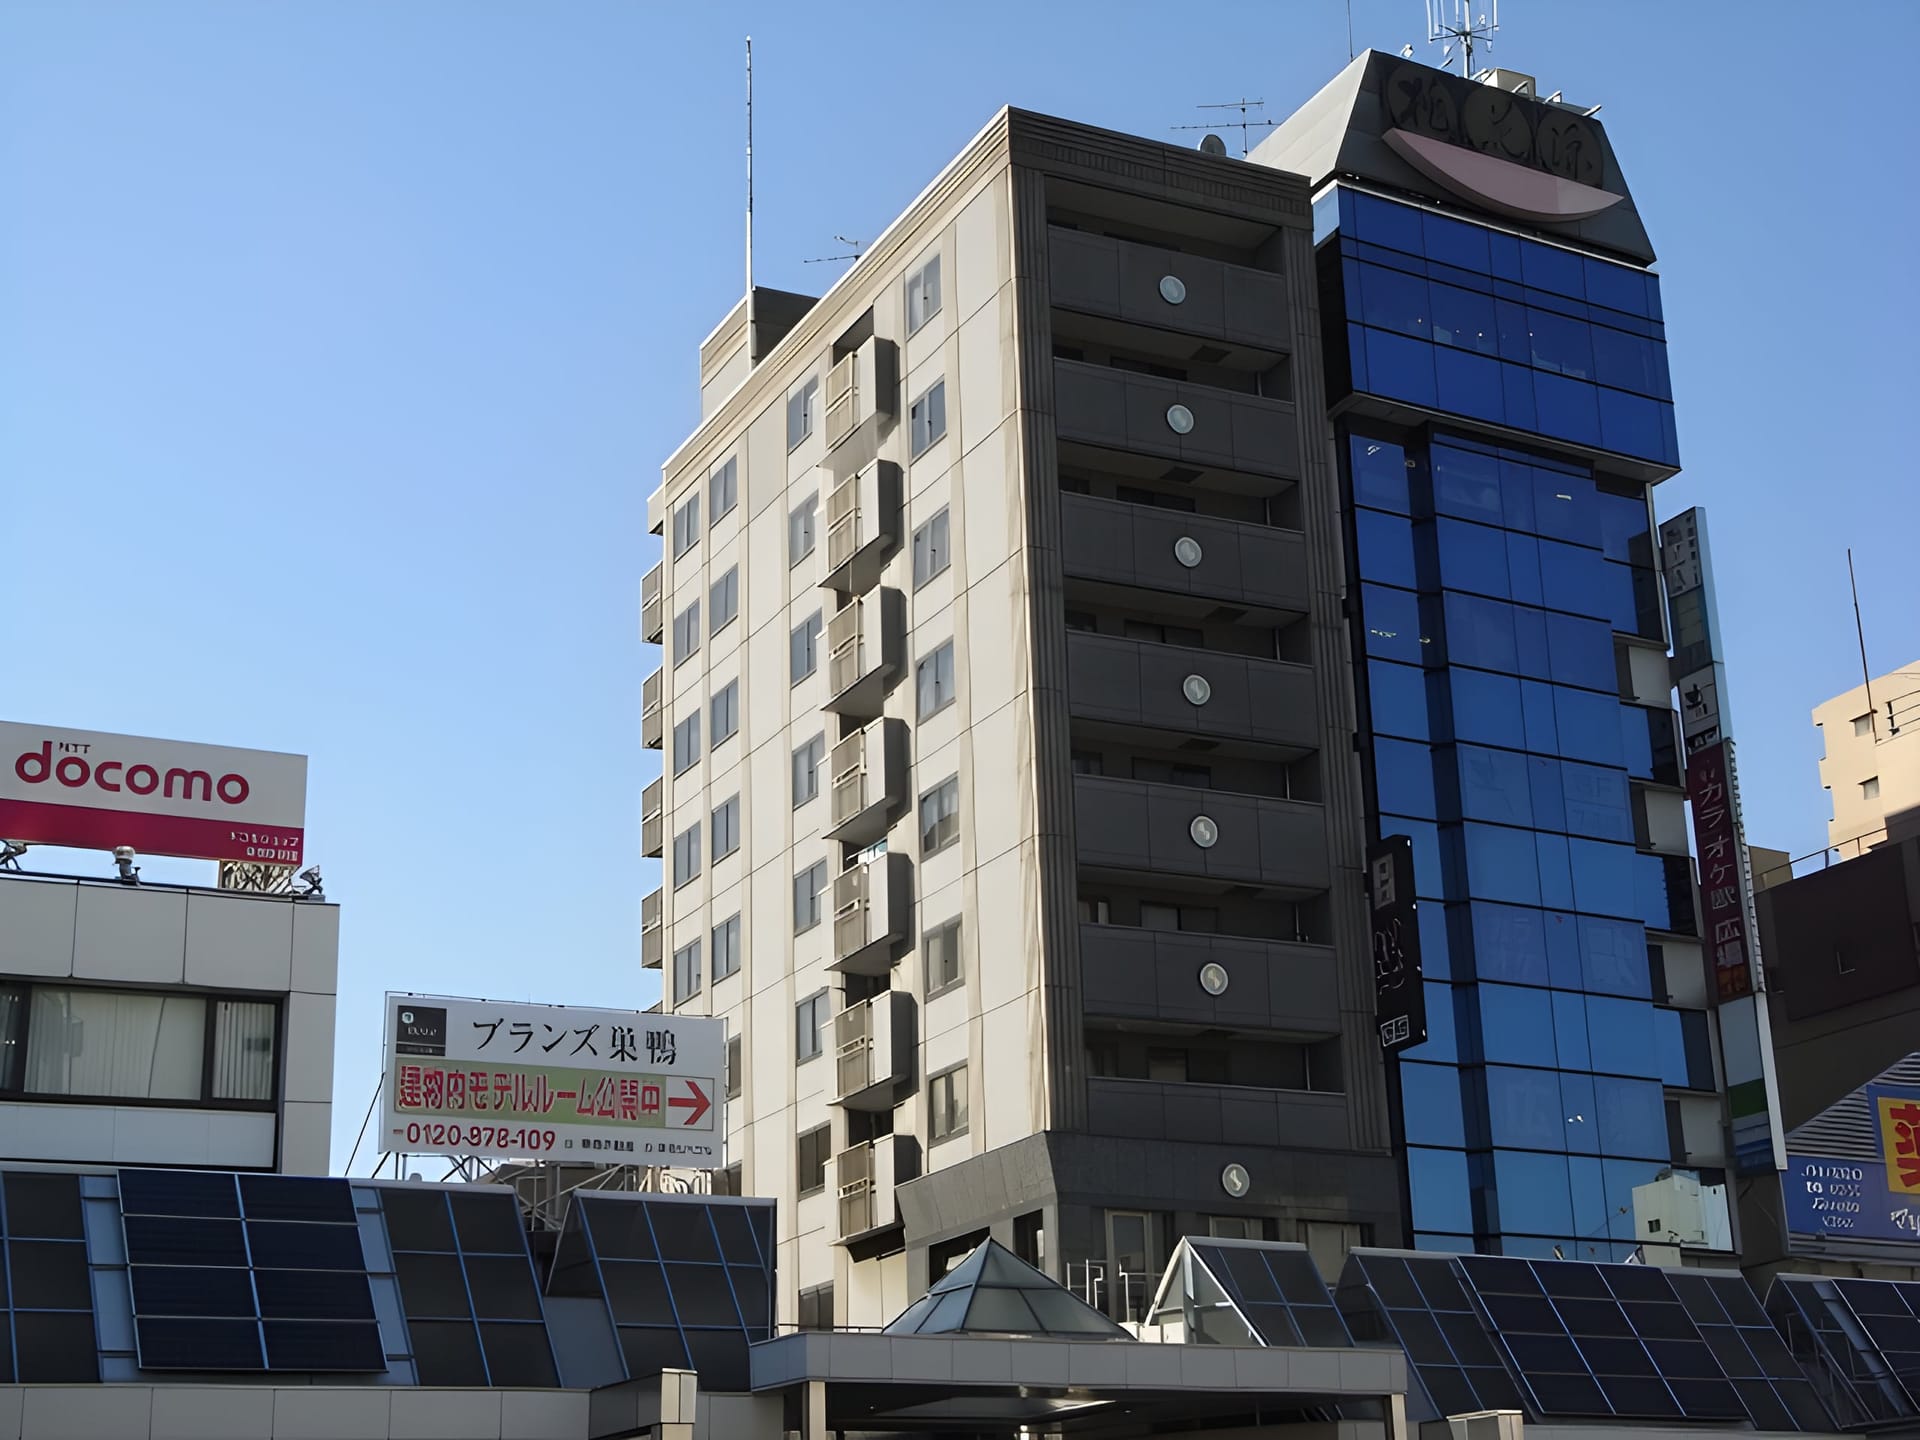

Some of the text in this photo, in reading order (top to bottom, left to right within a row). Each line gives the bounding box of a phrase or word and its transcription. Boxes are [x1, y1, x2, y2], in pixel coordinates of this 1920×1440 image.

[14, 740, 250, 805] docomo
[473, 1017, 677, 1066] ブランズ巣鴨
